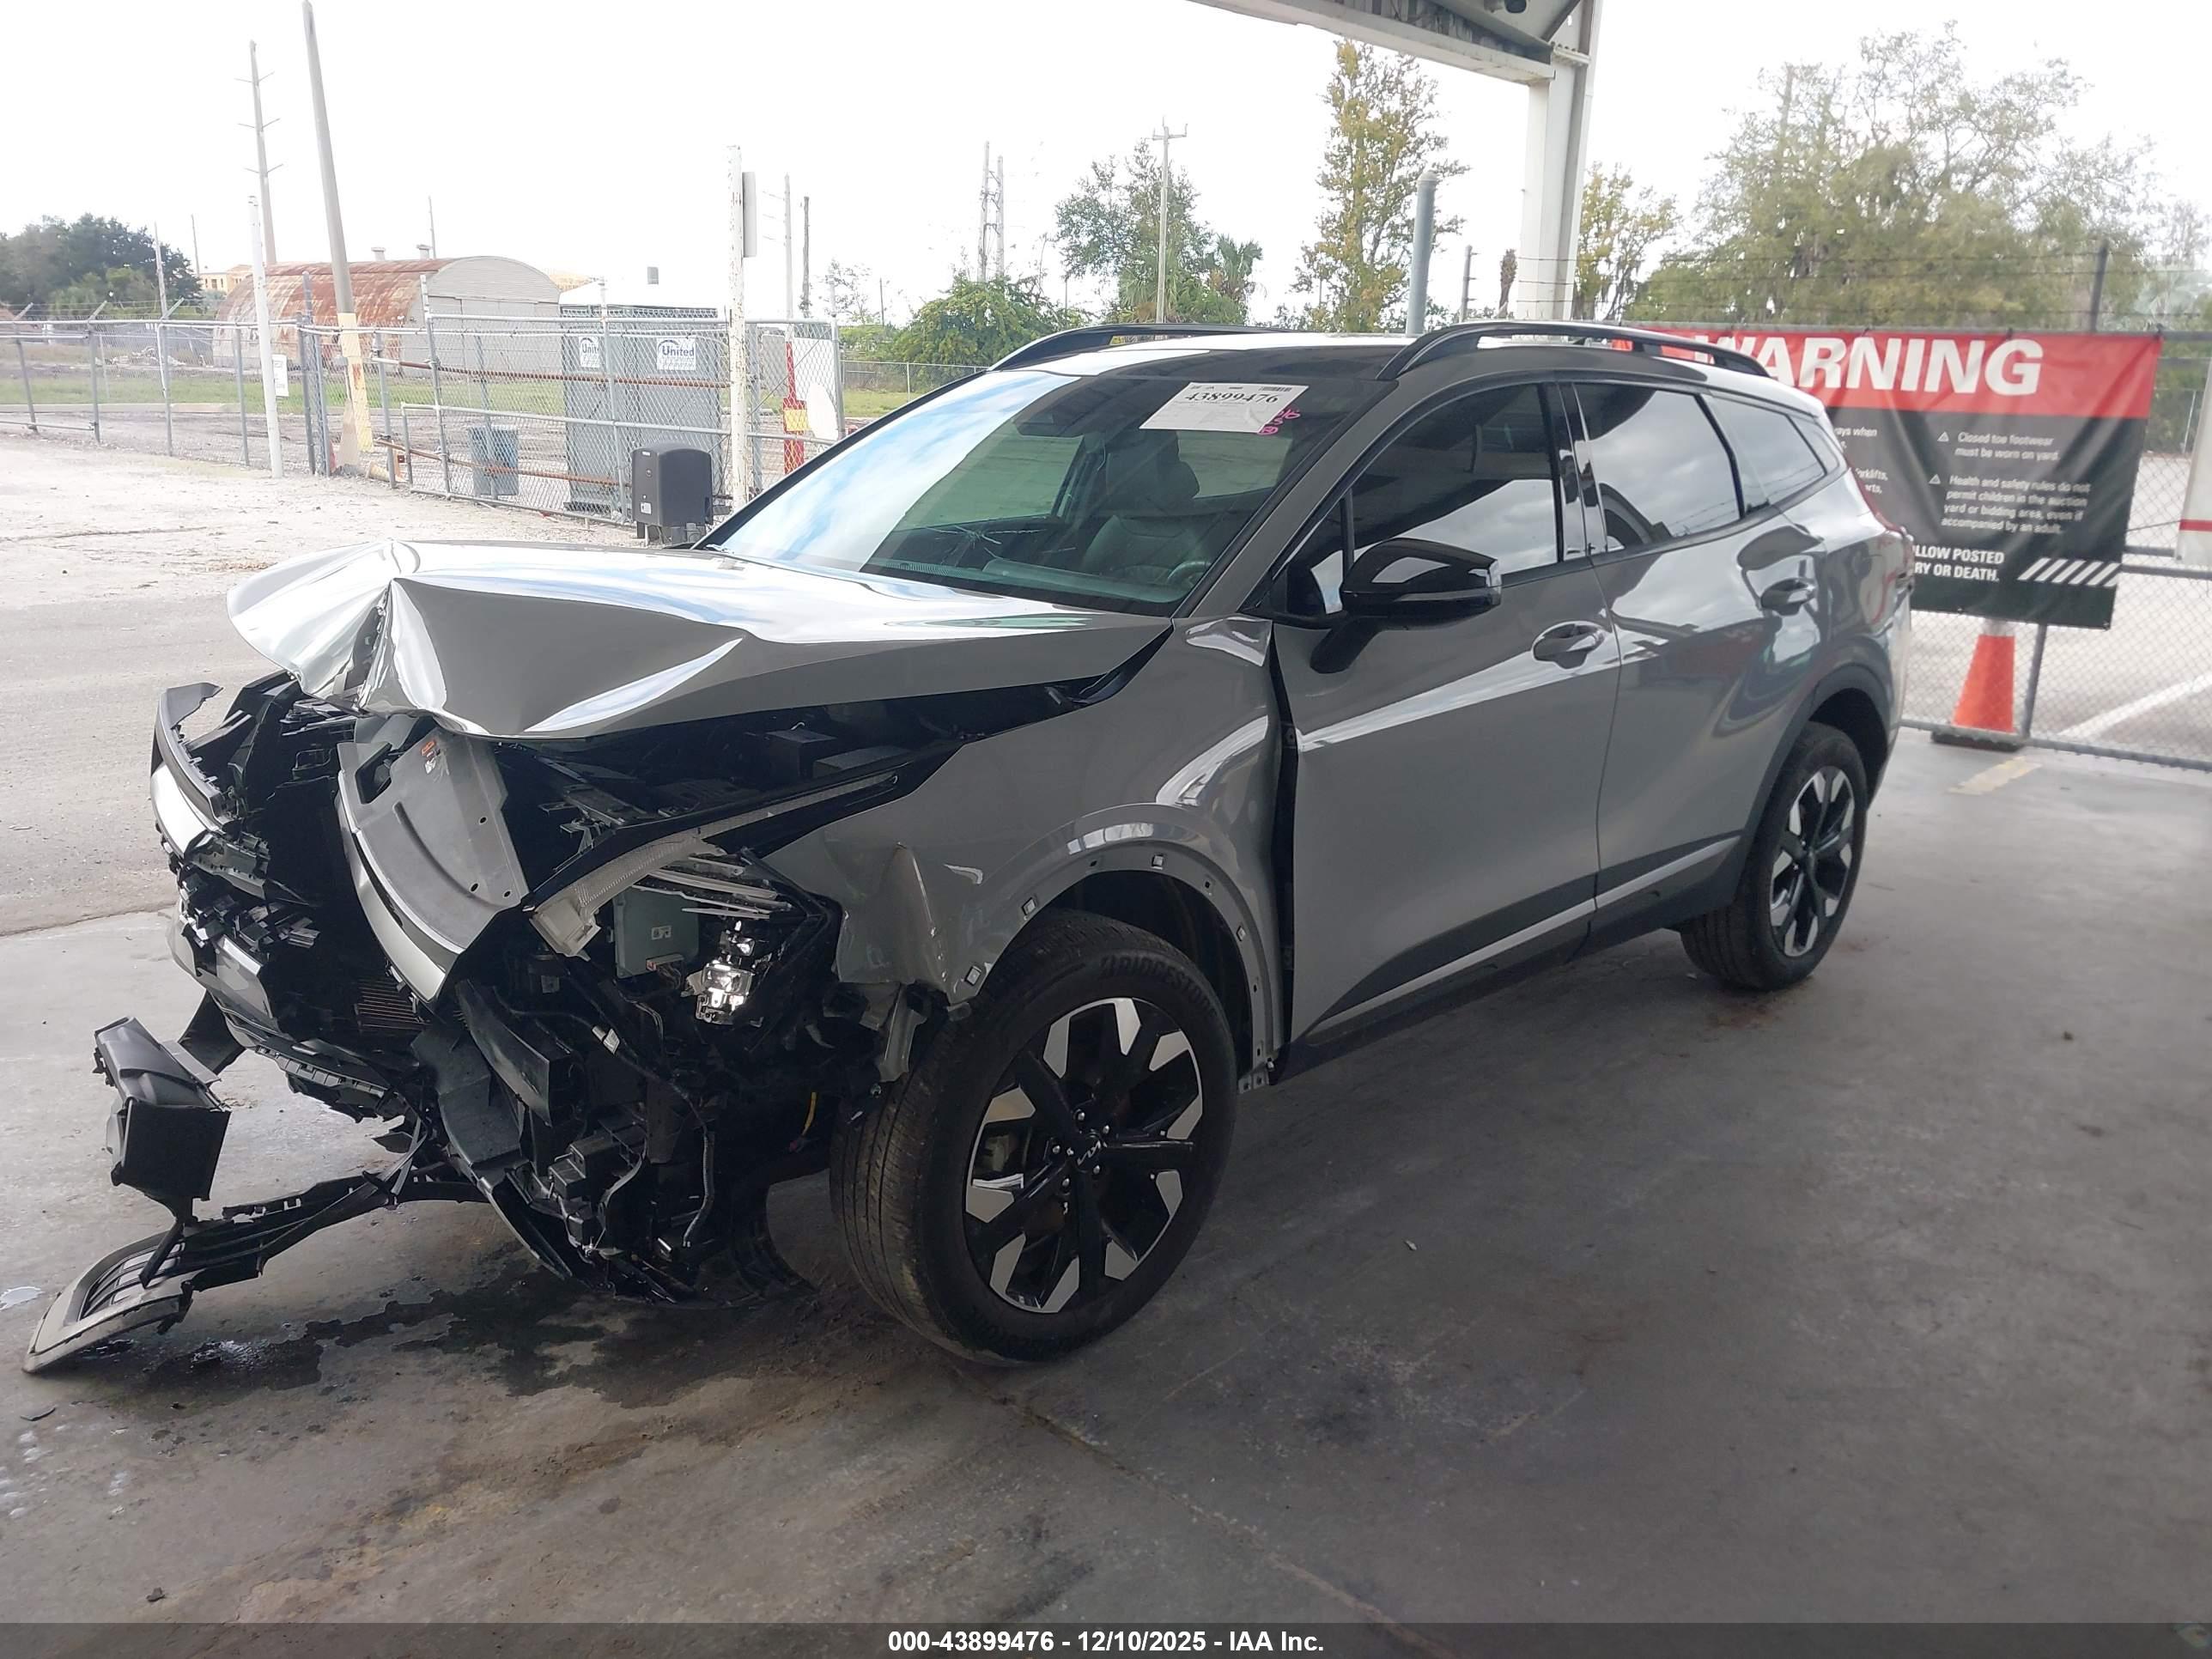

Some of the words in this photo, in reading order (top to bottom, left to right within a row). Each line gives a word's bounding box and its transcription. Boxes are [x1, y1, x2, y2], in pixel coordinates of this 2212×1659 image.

[662, 345, 695, 356] United
[1185, 392, 1279, 403] 43899476
[1853, 427, 1878, 436] when
[1957, 432, 1990, 444] Closed
[1991, 434, 2008, 444] toe
[2009, 434, 2054, 446] footwear
[1954, 448, 1978, 457] must
[1980, 448, 1993, 458] be
[1949, 475, 1980, 486] Health
[1981, 477, 2000, 488] and
[2001, 478, 2031, 490] safety
[2031, 482, 2056, 491] rules
[2057, 482, 2071, 491] do
[2072, 483, 2091, 493] not
[1946, 491, 1977, 500] permit
[1978, 491, 2015, 502] children
[2016, 494, 2026, 503] in
[2028, 495, 2045, 505] the
[2047, 496, 2087, 507] auction
[1944, 504, 1966, 514] yard
[1967, 506, 1979, 514] or
[1980, 505, 2016, 519] bidding
[2074, 510, 2083, 521] if
[1941, 518, 2004, 529] accompanied
[2005, 520, 2018, 532] by
[2020, 523, 2033, 532] an
[1953, 548, 2004, 564] POSTED
[1933, 563, 1952, 576] OR
[1954, 566, 2000, 582] DEATH.
